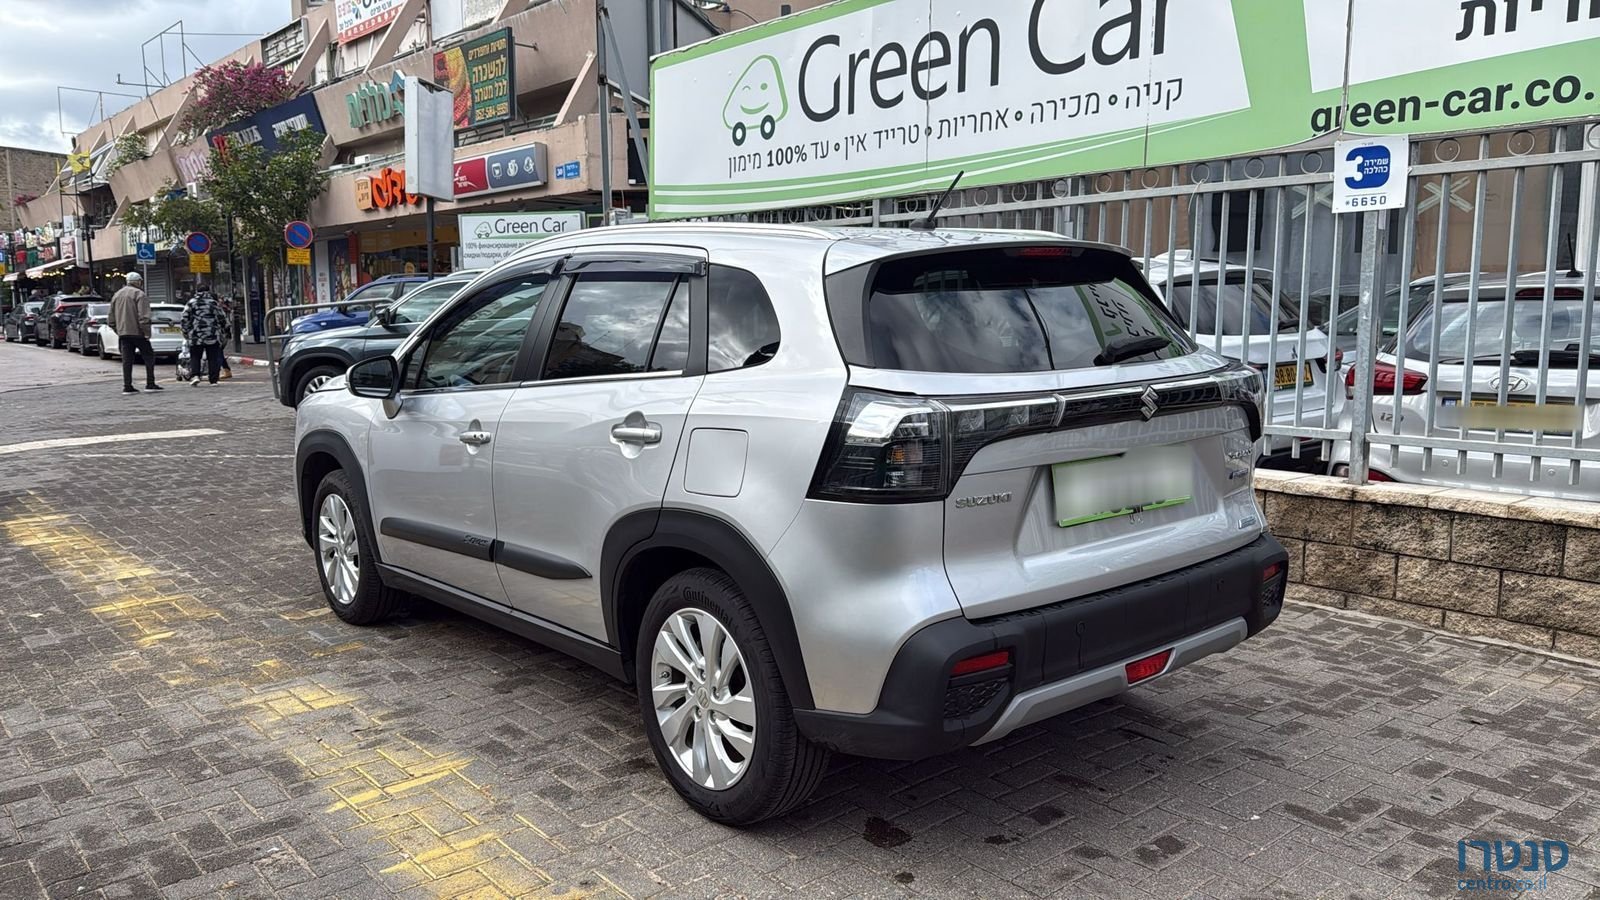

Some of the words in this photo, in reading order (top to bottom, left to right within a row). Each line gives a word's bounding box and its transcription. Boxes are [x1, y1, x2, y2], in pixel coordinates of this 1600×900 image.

[472, 54, 507, 84] להשכרה
[798, 18, 1001, 123] Green
[1028, 0, 1169, 75] Car
[475, 85, 494, 103] מטרה
[494, 79, 507, 97] לכל
[1125, 78, 1183, 110] קניה
[1030, 92, 1101, 124] מכירה
[937, 107, 1009, 140] אחריות
[844, 133, 868, 160] אין
[873, 124, 920, 150] טרייד
[767, 143, 808, 168] 100%
[811, 140, 830, 160] עד
[728, 152, 763, 179] מימון
[1363, 158, 1389, 167] שמירה
[1363, 165, 1388, 175] כהלכה
[494, 218, 539, 234] Green
[542, 217, 568, 233] Car
[464, 242, 478, 250] 100%
[1380, 412, 1404, 422] i2
[955, 491, 1012, 508] SUZUKI
